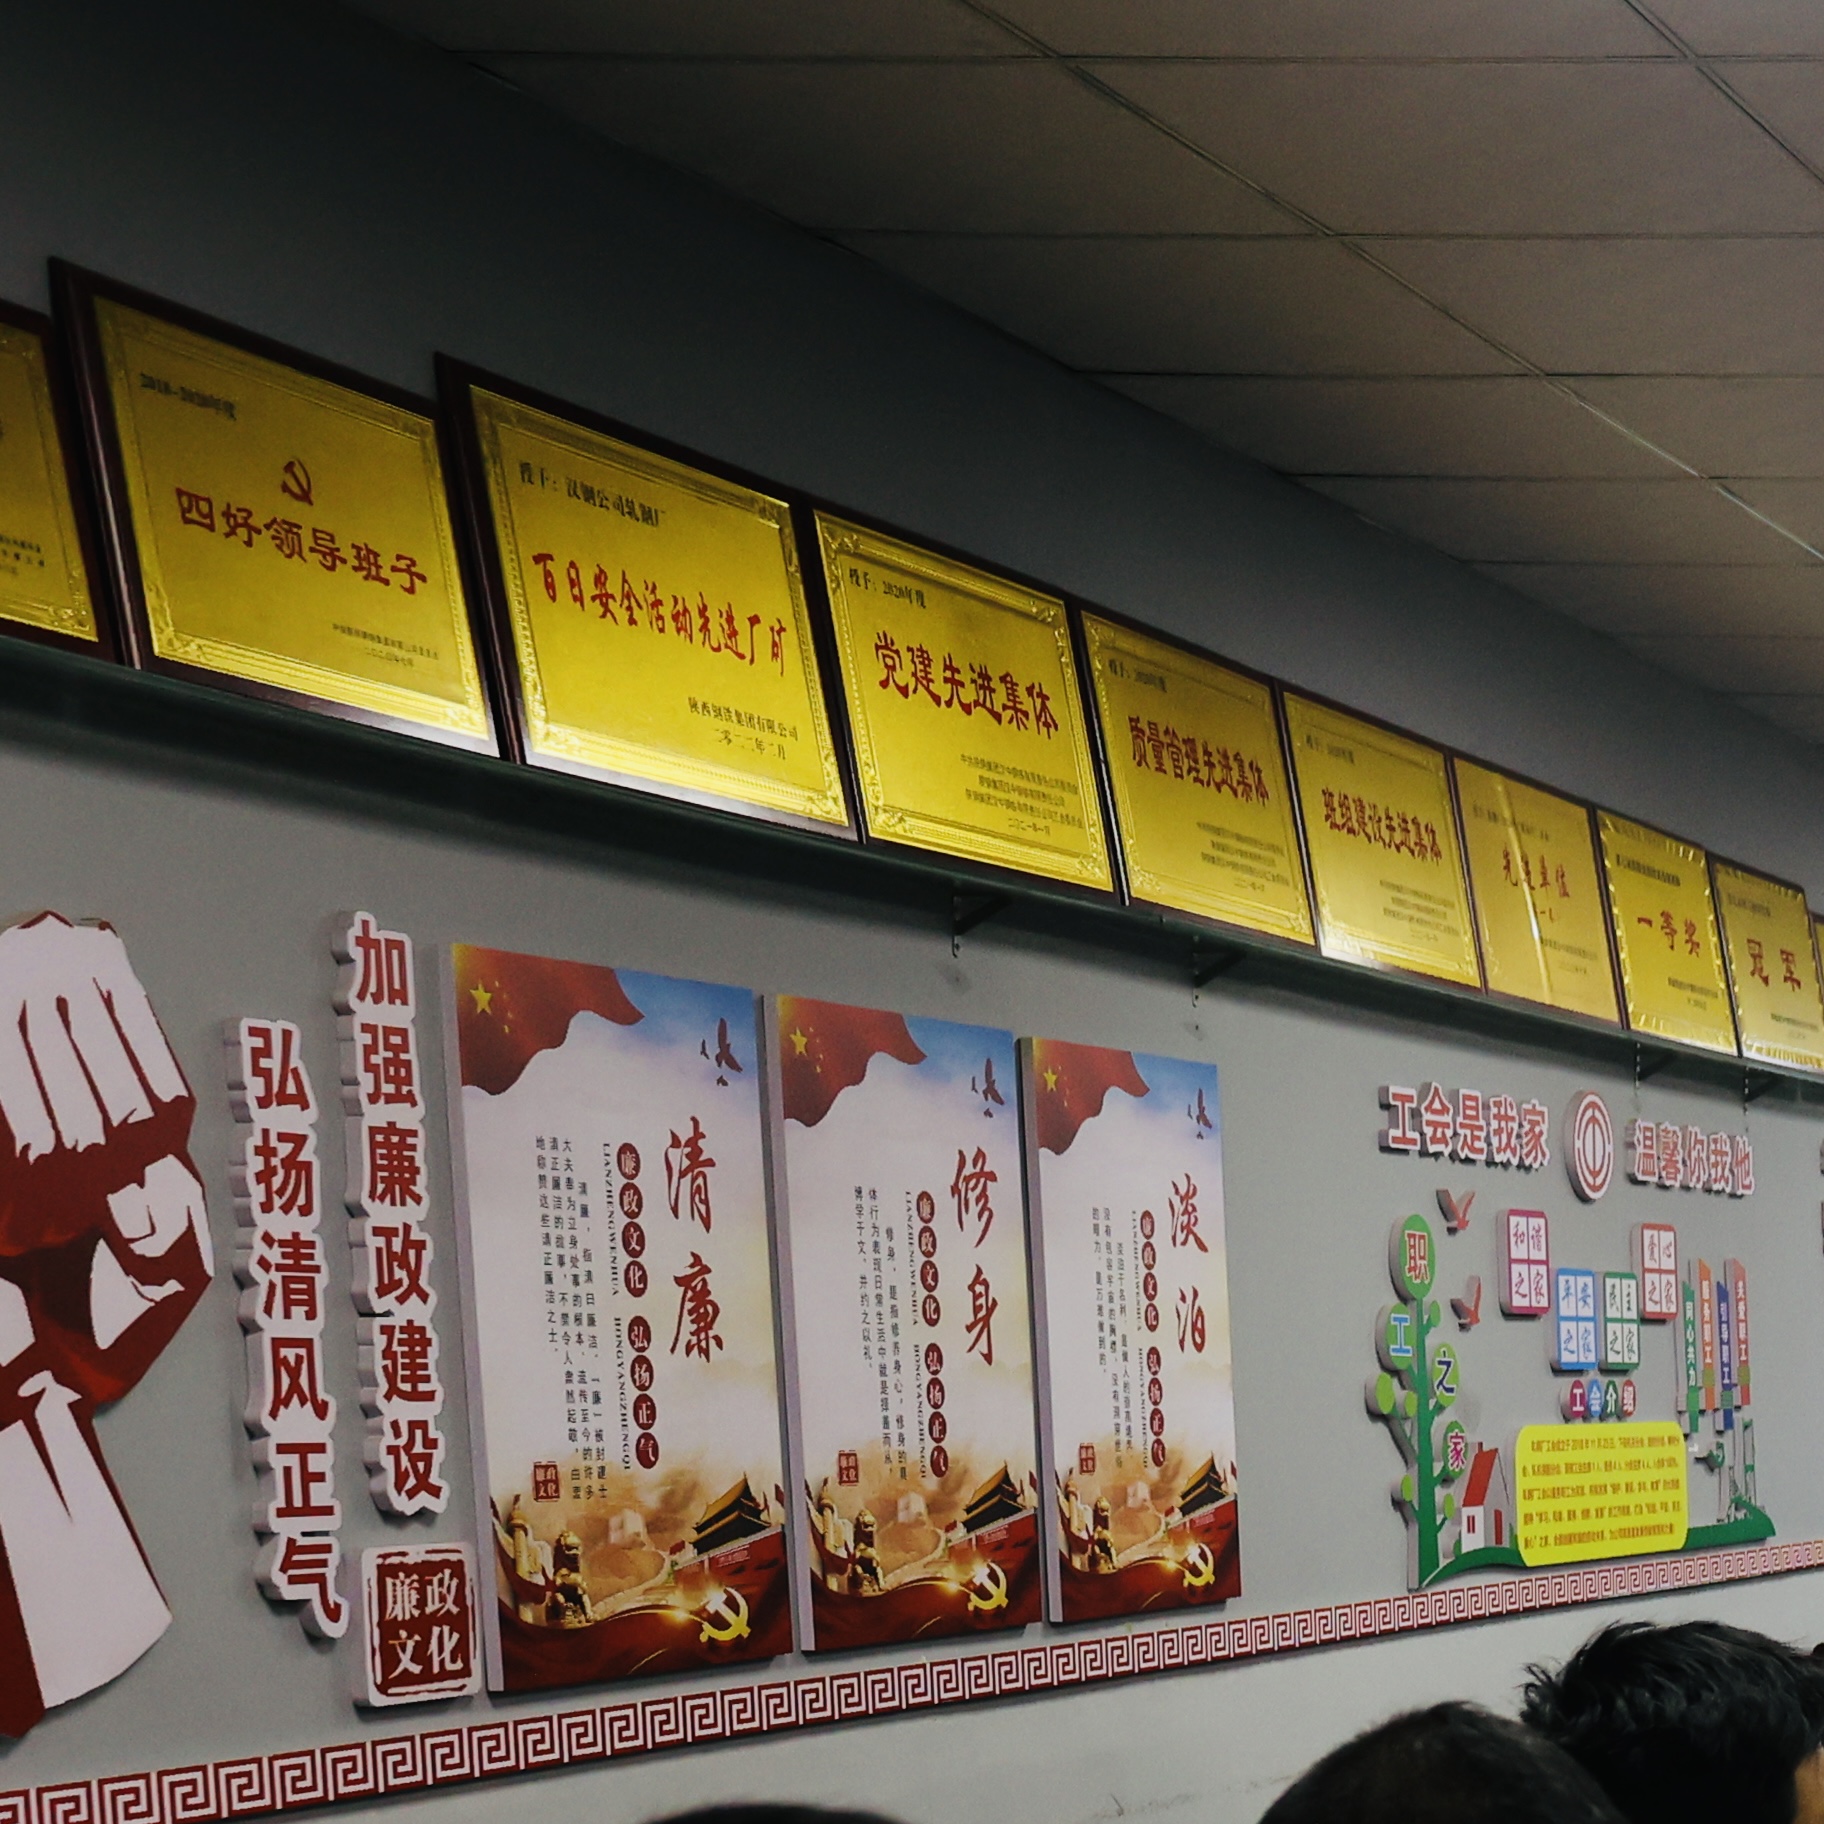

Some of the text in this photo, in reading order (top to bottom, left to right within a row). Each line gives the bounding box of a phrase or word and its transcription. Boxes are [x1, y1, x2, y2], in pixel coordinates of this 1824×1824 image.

[175, 487, 428, 595] 四好领导班子
[532, 553, 788, 678] 百日安全活动先进厂矿
[874, 630, 1059, 740] 党建先进集体
[1127, 715, 1270, 807] 质量管理先进集体
[1321, 786, 1443, 867] 班组建设先进集体
[1637, 910, 1701, 958] 一等奖
[1388, 1082, 1551, 1170] 工会是我家
[1634, 1119, 1756, 1198] 温馨你我他
[353, 919, 446, 1503] 加强廉政建设
[664, 1115, 726, 1364] 清廉
[1512, 1220, 1543, 1252] 和谐
[949, 1144, 999, 1367] 修身
[1169, 1171, 1210, 1357] 淡泊
[1513, 1268, 1545, 1305] 之家
[1561, 1277, 1592, 1310] 平安
[1609, 1282, 1633, 1314] 民主
[1647, 1278, 1674, 1314] 之家
[248, 1024, 343, 1624] 弘扬清风正气
[620, 1151, 656, 1462] 廉政文化 弘扬正气
[1389, 1227, 1467, 1470] 职工之家
[1562, 1327, 1592, 1361] 之家
[1609, 1327, 1636, 1361] 之家
[1572, 1384, 1635, 1413] 工会介绍
[386, 1566, 461, 1620] 廉政
[387, 1622, 463, 1678] 文化
